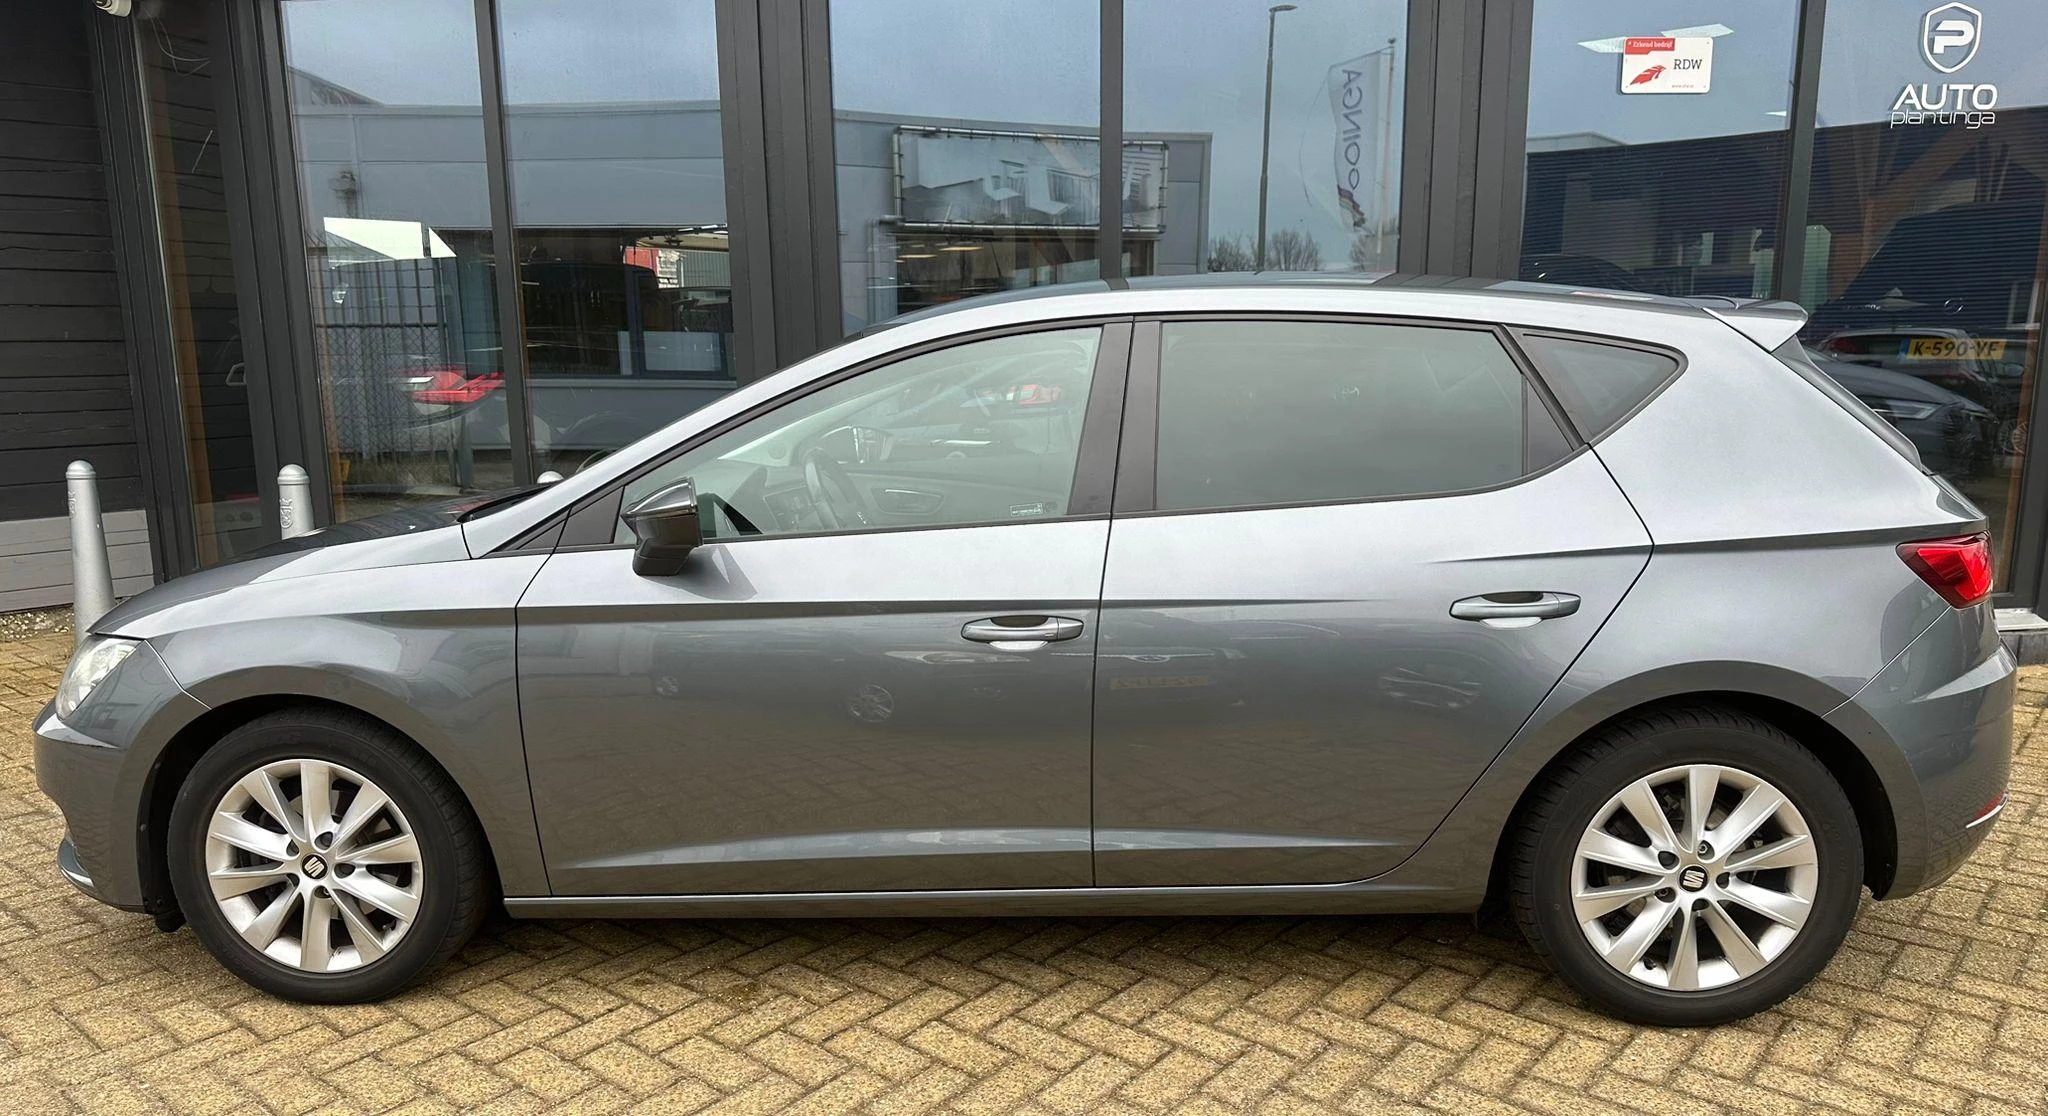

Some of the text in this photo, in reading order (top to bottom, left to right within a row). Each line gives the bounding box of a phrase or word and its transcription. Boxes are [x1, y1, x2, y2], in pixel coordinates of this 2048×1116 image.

[1673, 58, 1702, 70] RDW
[1892, 83, 1998, 110] AUTO
[1890, 109, 1996, 129] plantinga
[1913, 341, 2000, 356] K-590-VF
